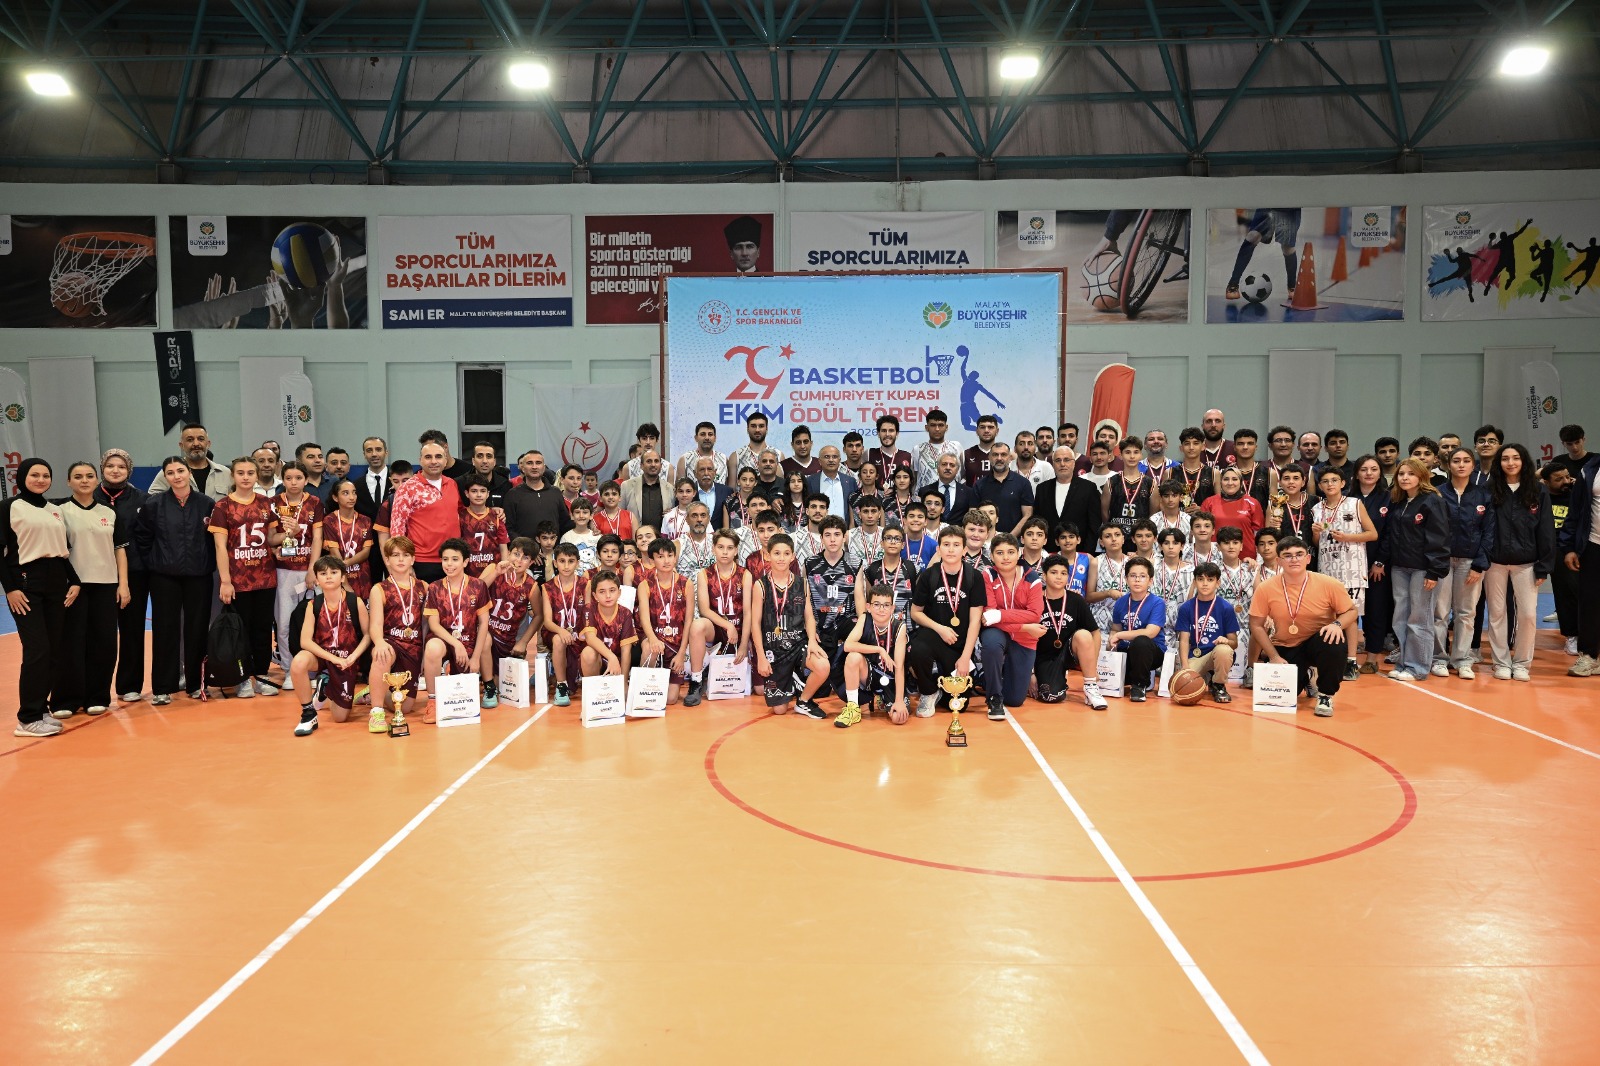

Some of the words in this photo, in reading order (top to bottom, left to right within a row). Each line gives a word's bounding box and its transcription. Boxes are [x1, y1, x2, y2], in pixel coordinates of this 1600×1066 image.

[456, 232, 495, 249] TÜM
[590, 232, 606, 246] Bir
[608, 232, 652, 245] milletin
[869, 228, 908, 246] TÜM
[395, 254, 557, 269] SPORCULARIMIZA
[590, 247, 631, 263] sporda
[633, 247, 691, 263] gösterdiği
[807, 250, 970, 265] SPORCULARIMIZA
[590, 263, 618, 277] azim
[620, 265, 627, 277] o
[630, 263, 673, 276] milletin
[387, 273, 490, 291] BAŞARILAR
[494, 269, 566, 287] DİLERİM
[590, 279, 650, 294] geleceğini
[427, 309, 445, 320] ER
[752, 307, 788, 317] GENÇLİK
[957, 310, 1027, 320] BÜYÜKŞEHİR
[758, 316, 802, 325] BAKANLIĞI
[789, 366, 939, 385] BASKETBOL
[789, 390, 882, 401] CUMHURİYET
[887, 390, 939, 400] KUPASI
[789, 403, 852, 423] ÖDÜL
[981, 460, 991, 471] 13
[237, 522, 266, 548] 15
[474, 532, 485, 551] 7
[234, 547, 268, 560] Beytepe
[826, 585, 839, 598] 99
[1348, 588, 1360, 600] 47
[491, 599, 515, 620] 13
[659, 602, 672, 623] 4
[450, 611, 465, 633] 4
[591, 698, 620, 706] MALATYA
